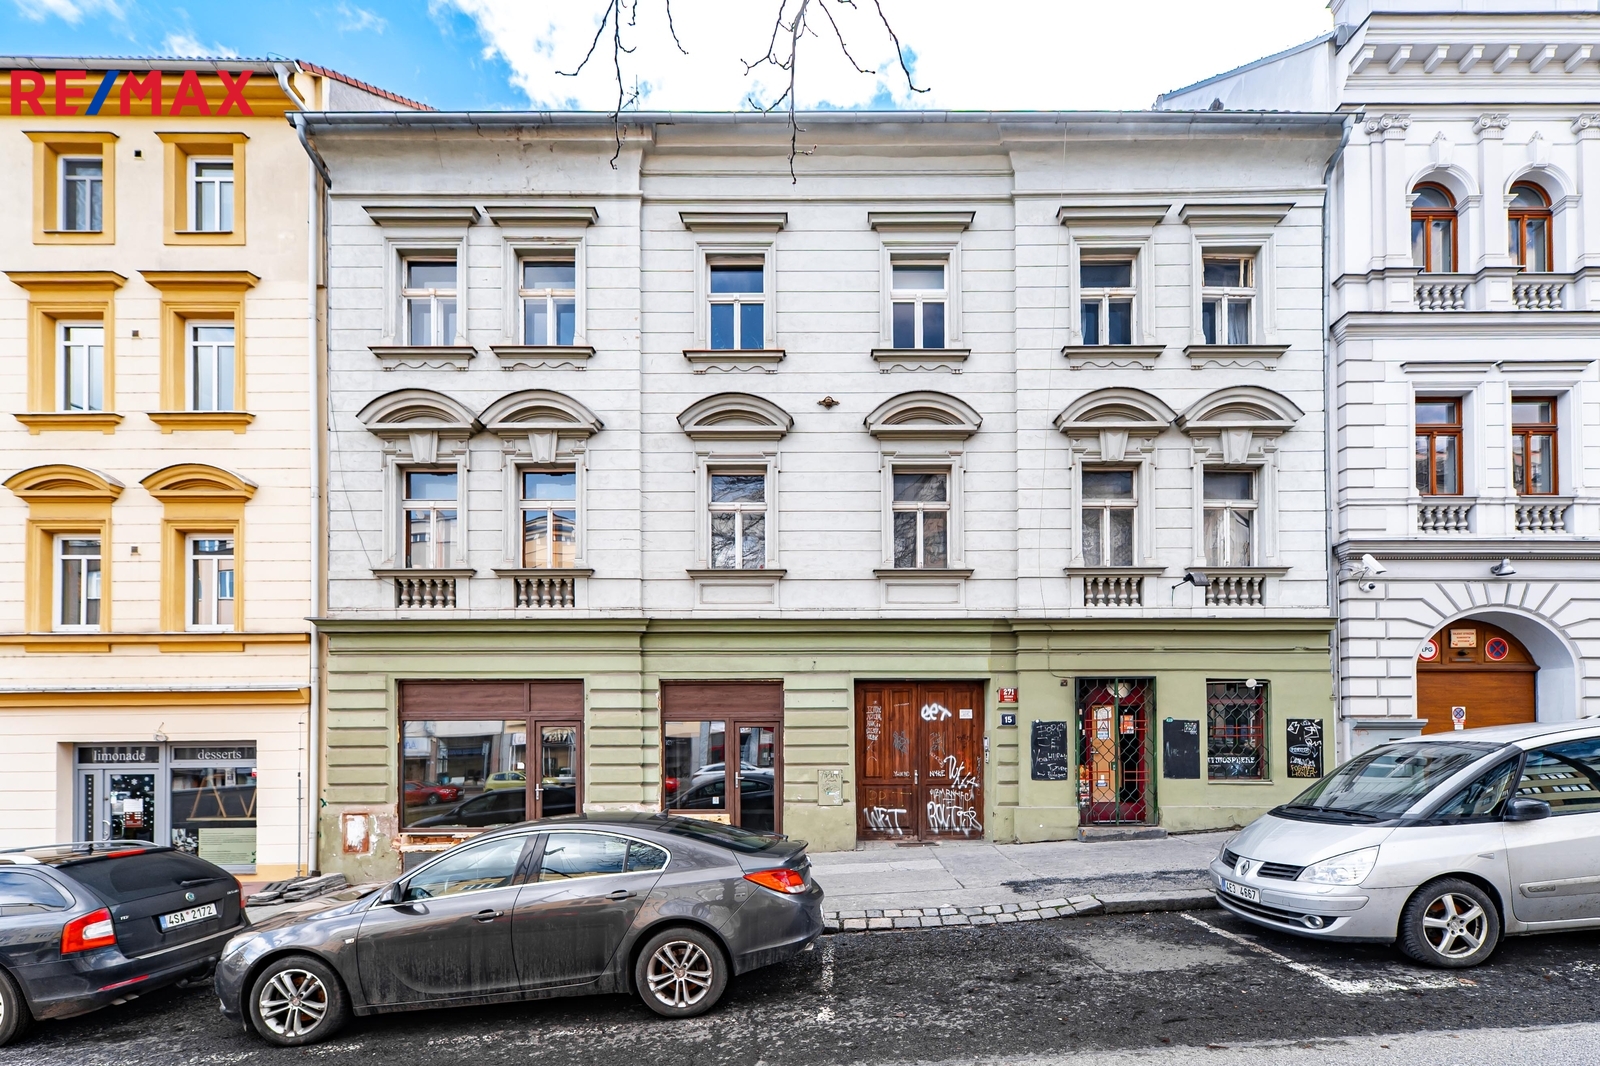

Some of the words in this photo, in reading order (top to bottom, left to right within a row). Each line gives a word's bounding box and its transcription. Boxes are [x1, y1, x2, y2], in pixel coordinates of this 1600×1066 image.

[1003, 688, 1014, 696] 271
[1004, 715, 1012, 723] 15
[93, 749, 146, 761] limonade
[197, 749, 242, 760] desserts
[1226, 882, 1236, 894] 4E3
[168, 913, 186, 925] 4SA
[192, 906, 213, 919] 2172
